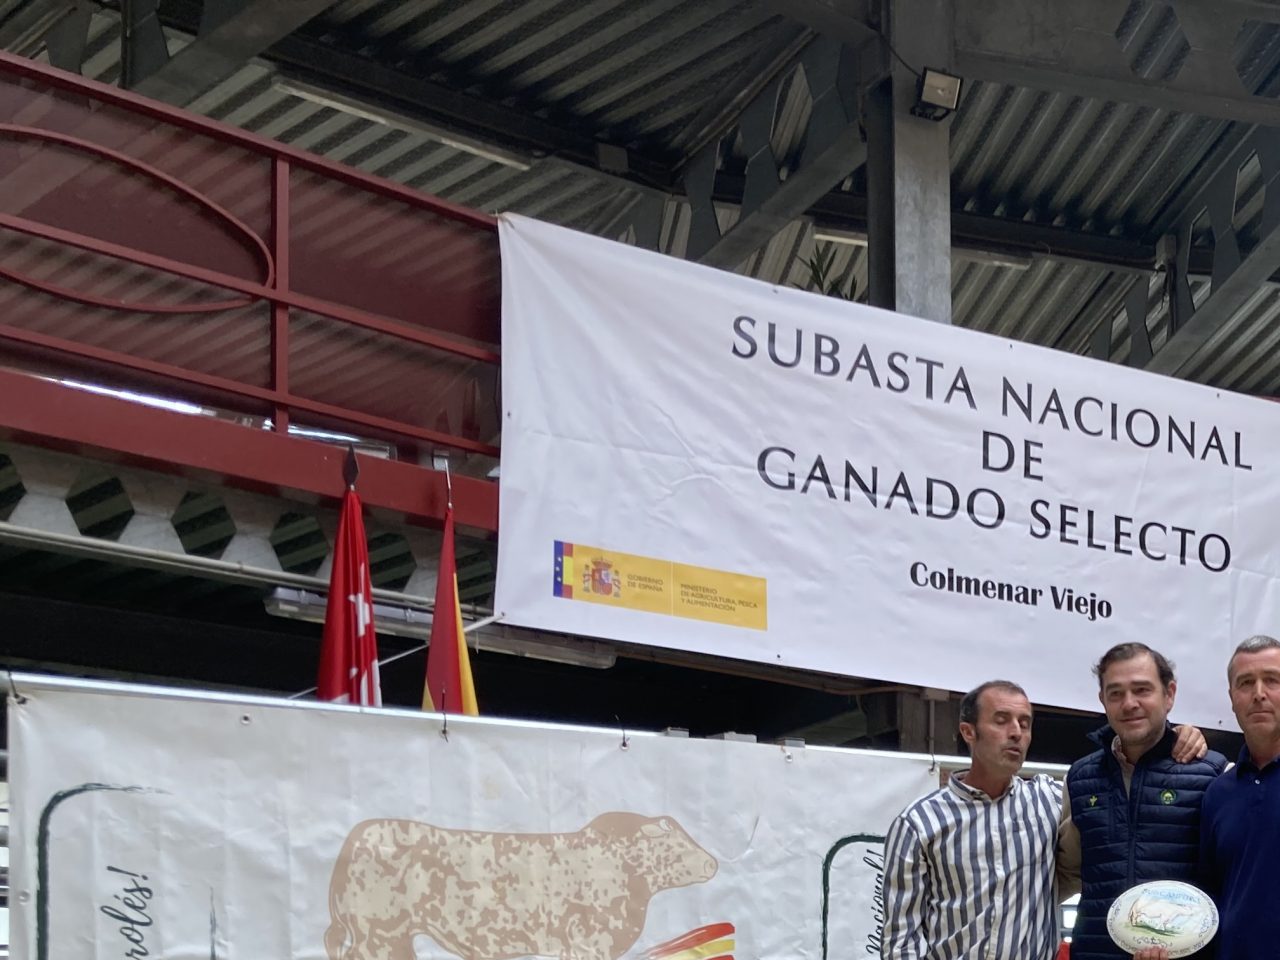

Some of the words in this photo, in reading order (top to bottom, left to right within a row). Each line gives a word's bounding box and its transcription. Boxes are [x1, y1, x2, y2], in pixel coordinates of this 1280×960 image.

[732, 316, 978, 410] SUBASTA
[1001, 375, 1253, 471] NACIONAL
[981, 430, 1044, 482] DE
[757, 447, 1006, 529] GANADO
[1030, 498, 1232, 573] SELECTO
[627, 573, 664, 586] GOBIERNO
[638, 581, 664, 593] ESPAÑA
[680, 583, 718, 594] MINISTERIO
[909, 561, 1042, 606] Colmenar
[1050, 585, 1113, 621] Viejo
[738, 599, 758, 609] PESCA
